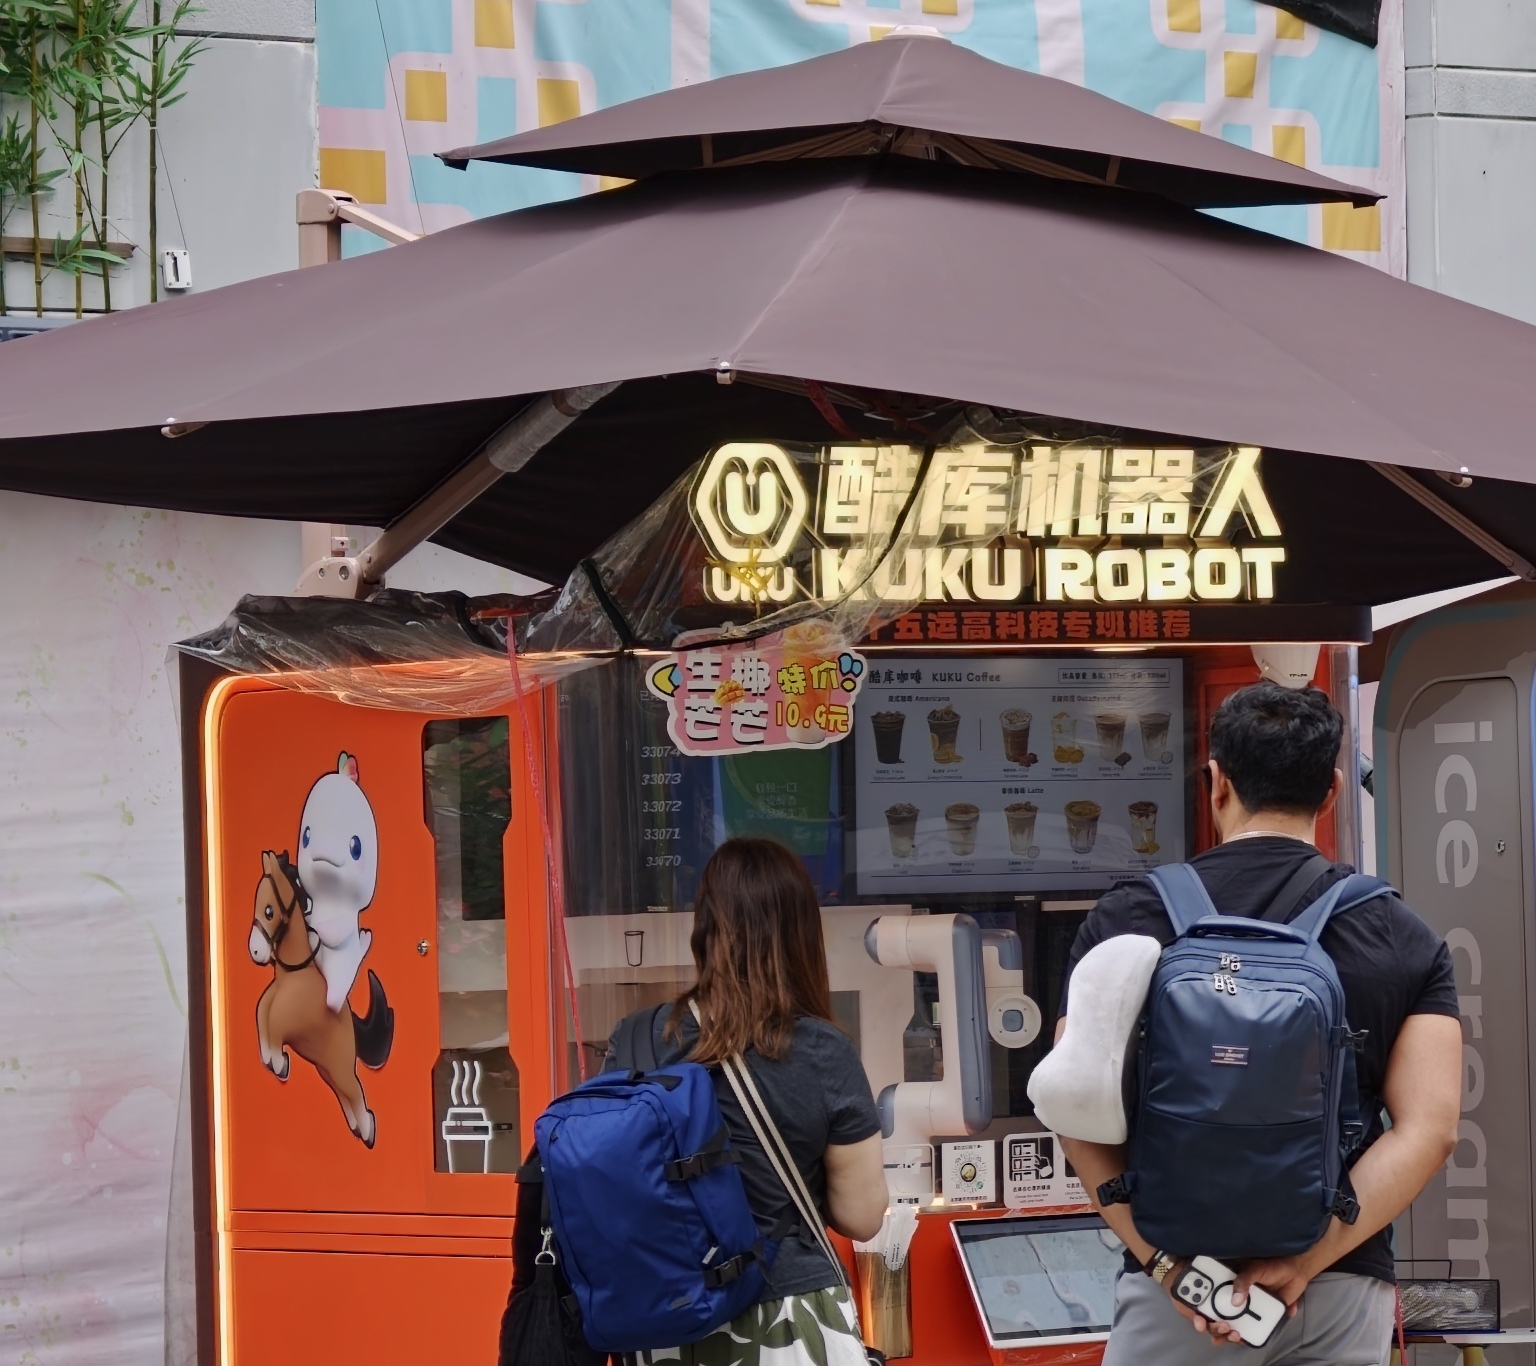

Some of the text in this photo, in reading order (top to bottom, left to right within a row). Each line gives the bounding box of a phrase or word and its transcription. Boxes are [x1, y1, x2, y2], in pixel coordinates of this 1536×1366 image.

[822, 444, 1283, 537] 酷库机器人
[820, 547, 1286, 601] KUKU ROBOT
[685, 648, 771, 697] 生椰
[776, 659, 839, 695] 特价
[868, 670, 1000, 684] 酷库咖啡 KUKU Coffee
[684, 695, 769, 745] 芒芒
[641, 745, 681, 758] 33074
[641, 773, 682, 786] 33073
[642, 800, 682, 813] 33072
[1434, 720, 1493, 889] ice
[643, 828, 681, 840] 33071
